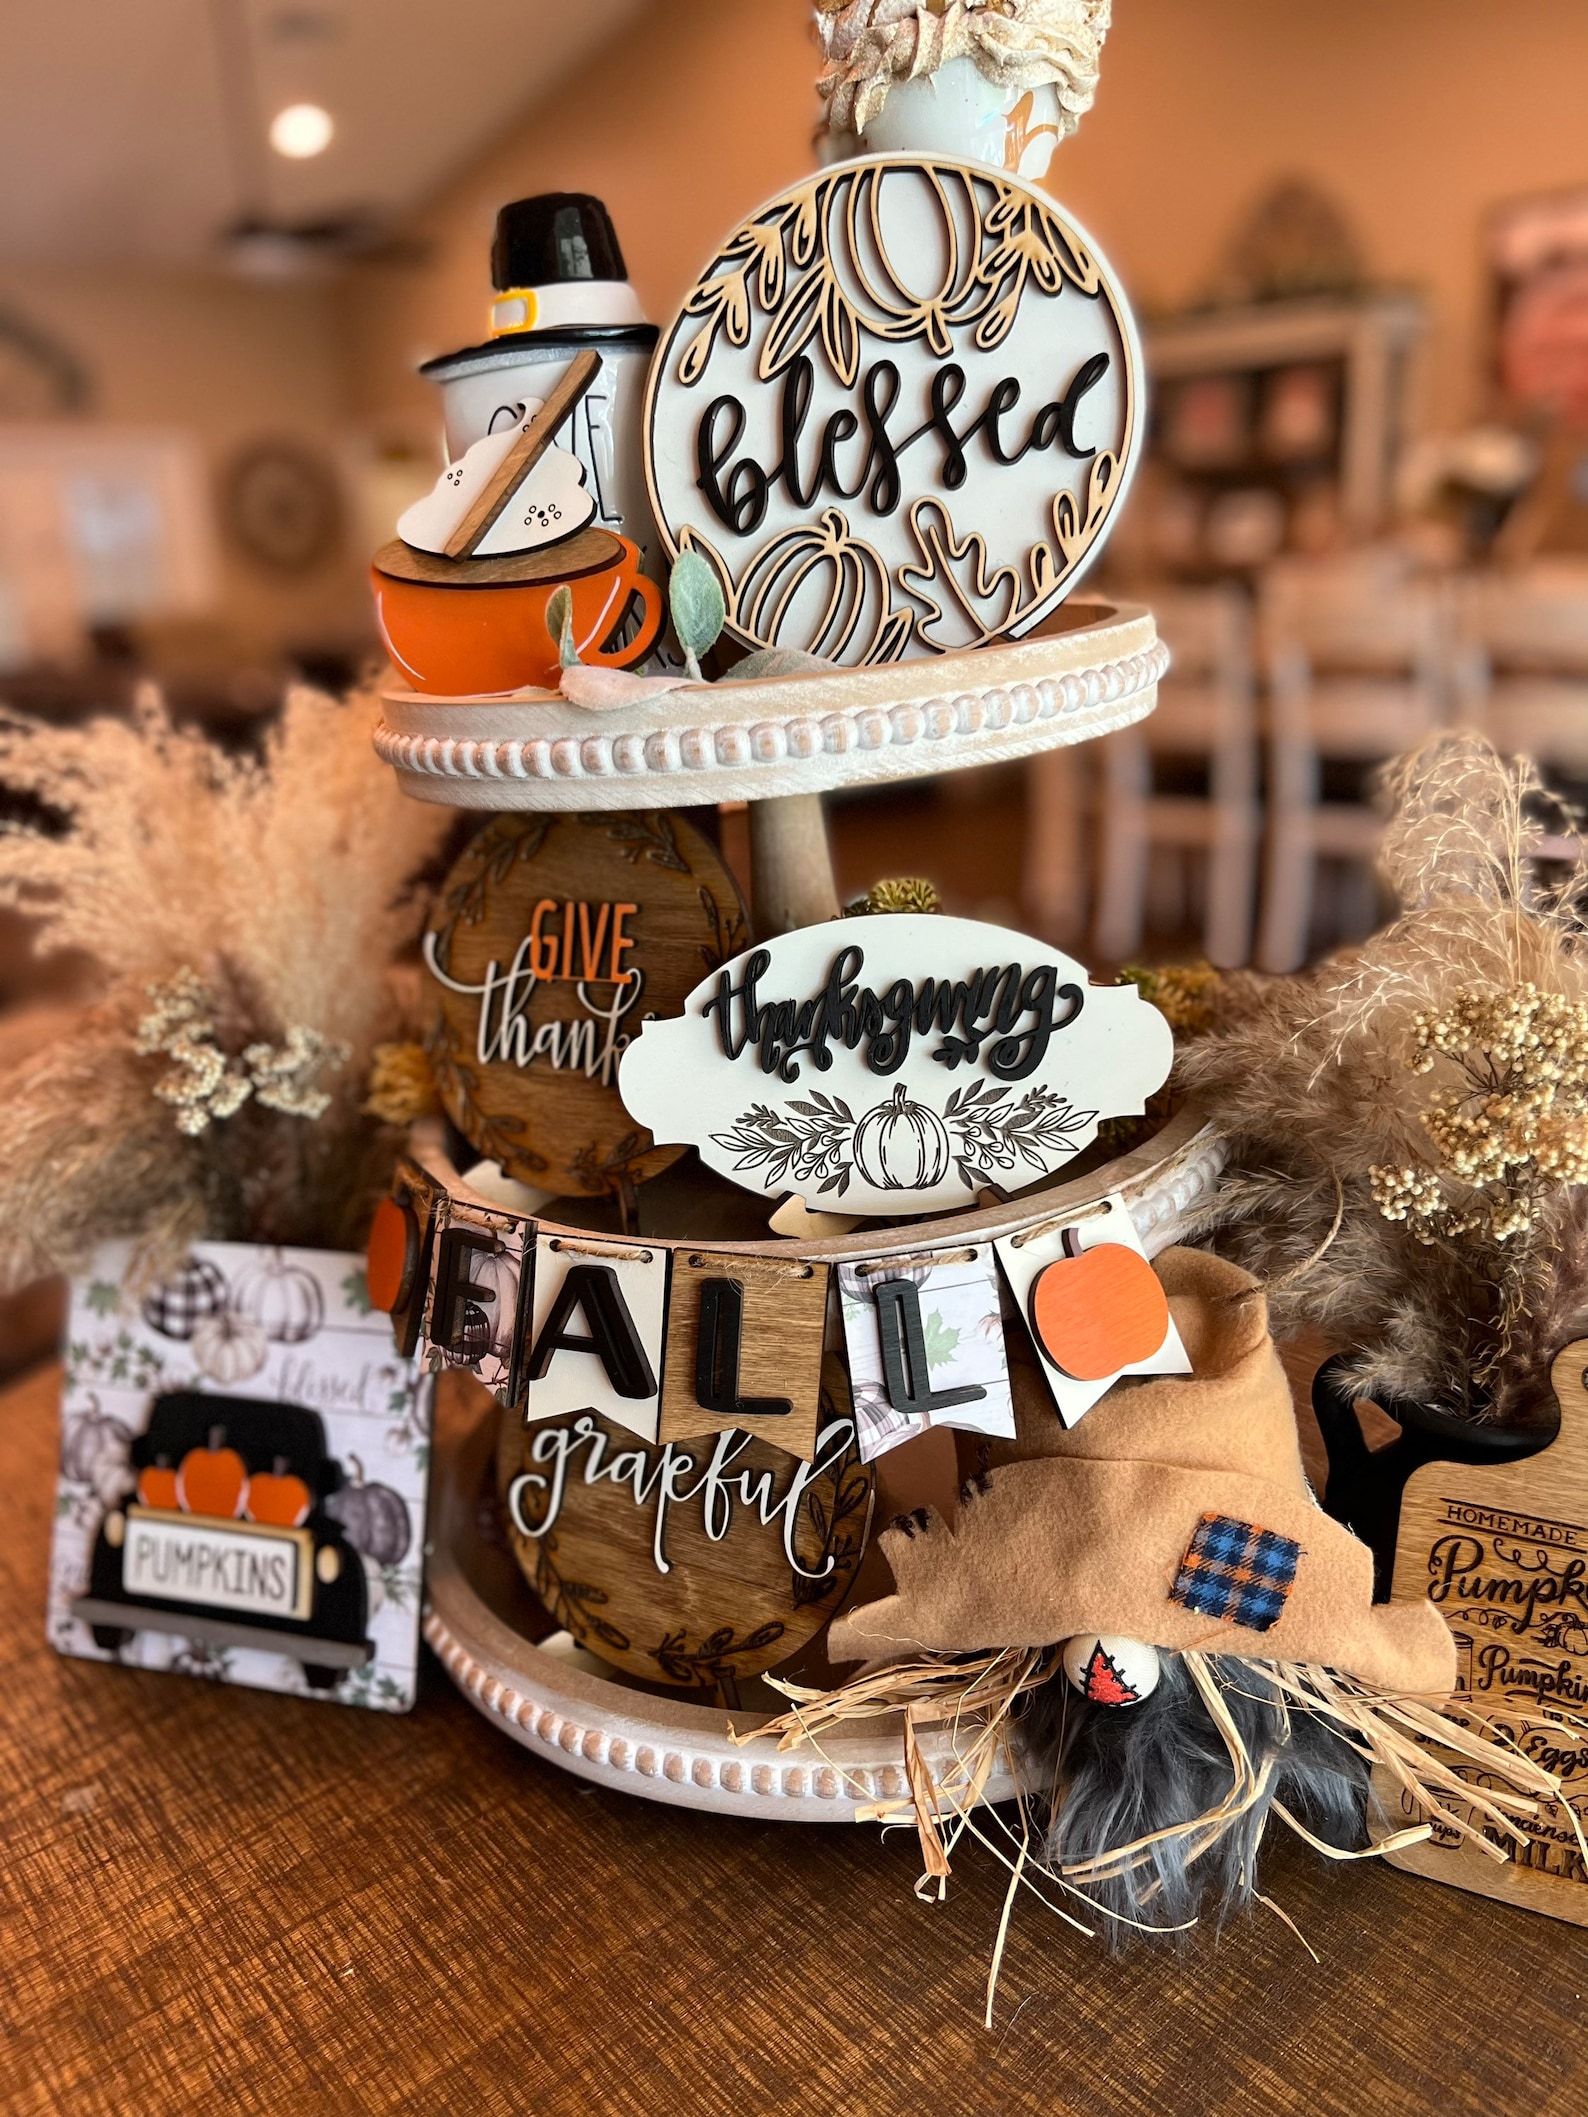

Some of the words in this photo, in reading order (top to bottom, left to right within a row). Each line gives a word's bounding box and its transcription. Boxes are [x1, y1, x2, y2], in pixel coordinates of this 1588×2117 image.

[696, 352, 1110, 536] blessed
[530, 899, 637, 984] GIVE
[423, 930, 655, 1087] thank
[702, 945, 1084, 1083] thanksgiving
[509, 1416, 856, 1579] grateful
[1446, 1504, 1578, 1546] HOMEMADE
[134, 1533, 289, 1602] PUMPKINS
[1428, 1534, 1588, 1635] Pumpk
